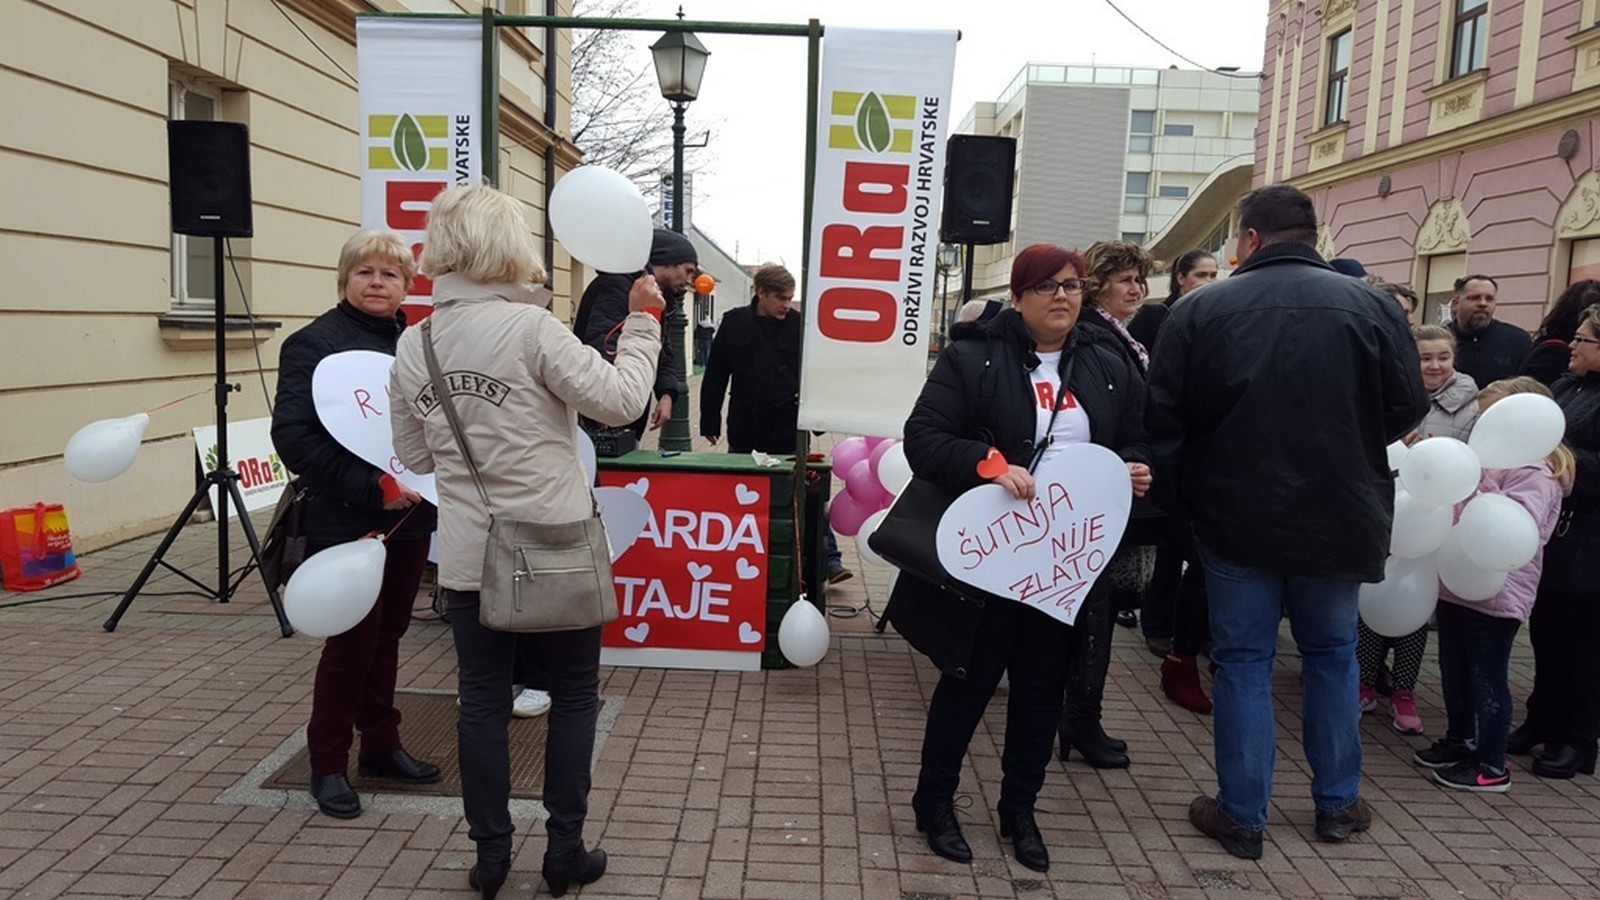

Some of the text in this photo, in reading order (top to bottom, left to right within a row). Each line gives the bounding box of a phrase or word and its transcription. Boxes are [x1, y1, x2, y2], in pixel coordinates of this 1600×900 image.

[903, 97, 939, 345] ODRŽIVI RAZVOJ HRVATSKE
[614, 576, 732, 623] TAJE
[1009, 549, 1105, 600] ZLATO
